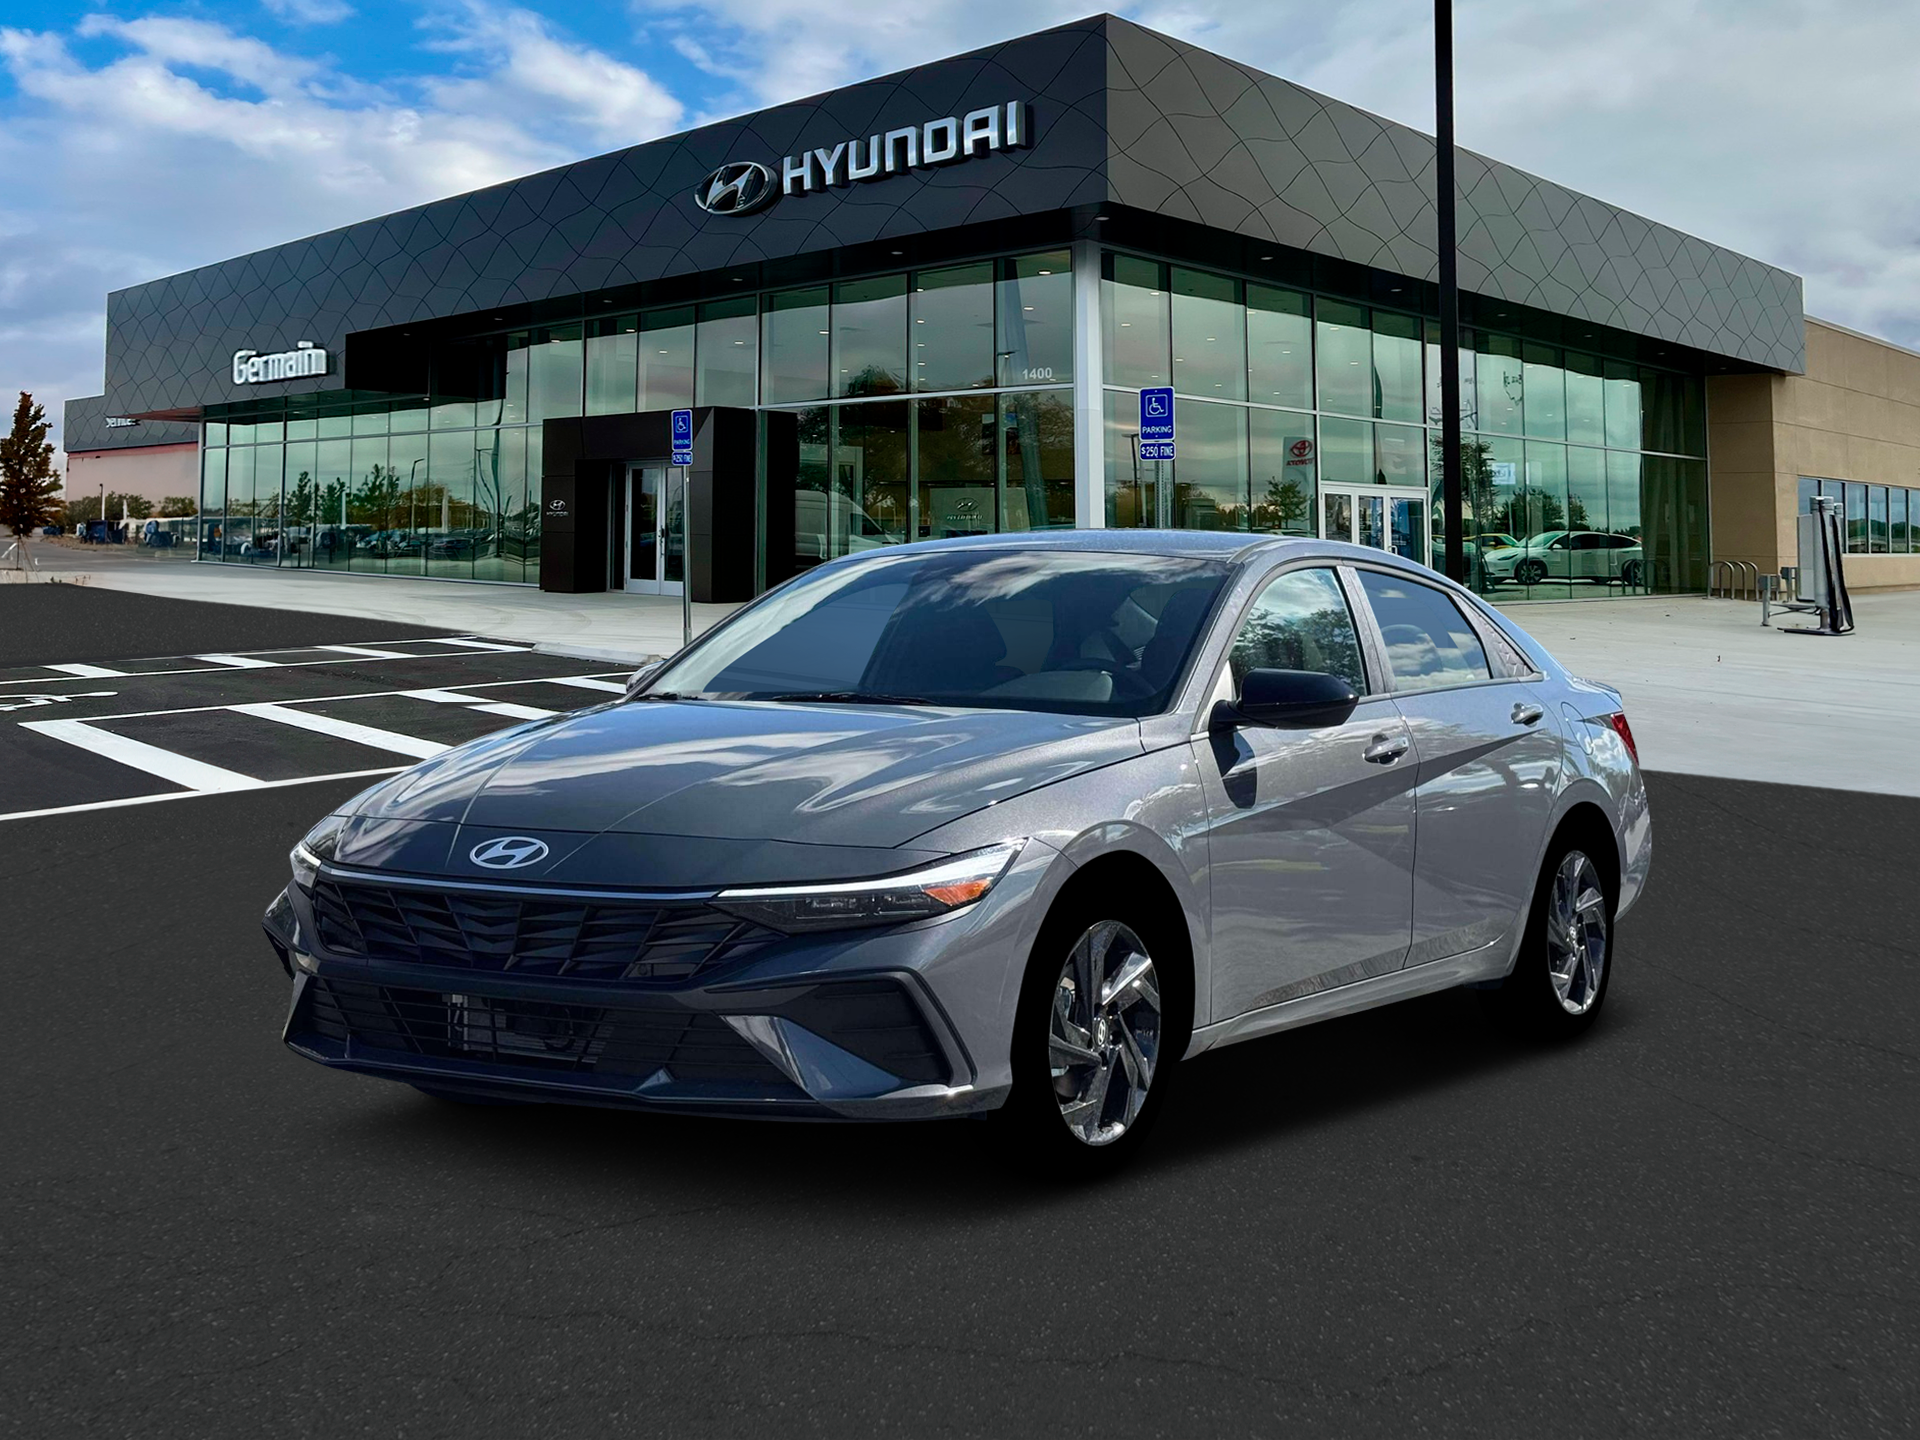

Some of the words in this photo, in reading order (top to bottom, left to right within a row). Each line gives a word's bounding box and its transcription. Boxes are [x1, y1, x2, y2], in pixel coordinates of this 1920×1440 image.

[783, 100, 1024, 195] HYUNDAI
[233, 340, 327, 385] Germain
[1022, 367, 1053, 380] 1400
[1142, 425, 1173, 434] PARKING
[1141, 446, 1159, 457] $250
[1160, 445, 1174, 456] FINE
